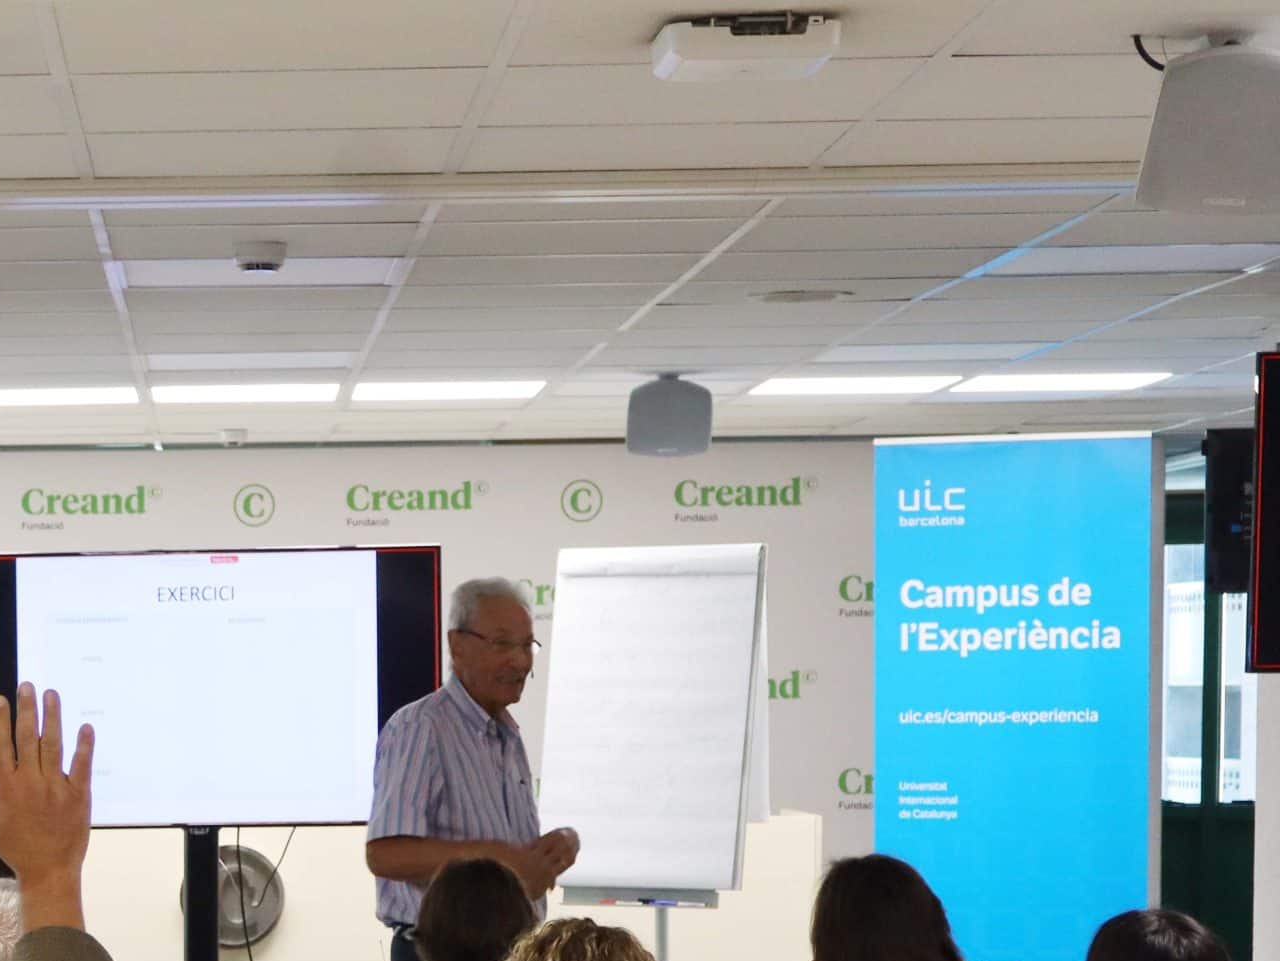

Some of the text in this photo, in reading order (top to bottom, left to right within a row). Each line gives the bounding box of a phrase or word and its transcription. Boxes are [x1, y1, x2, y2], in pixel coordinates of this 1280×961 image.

[20, 485, 146, 516] Creand
[345, 479, 472, 512] Creand
[673, 475, 802, 508] Creand
[898, 515, 965, 527] barcelona
[156, 585, 236, 603] EXERCICI
[899, 578, 1040, 615] Campus
[1047, 576, 1093, 607] de
[899, 618, 1121, 658] l'Experiència
[898, 707, 1100, 727] uic.es/campus-experiencia
